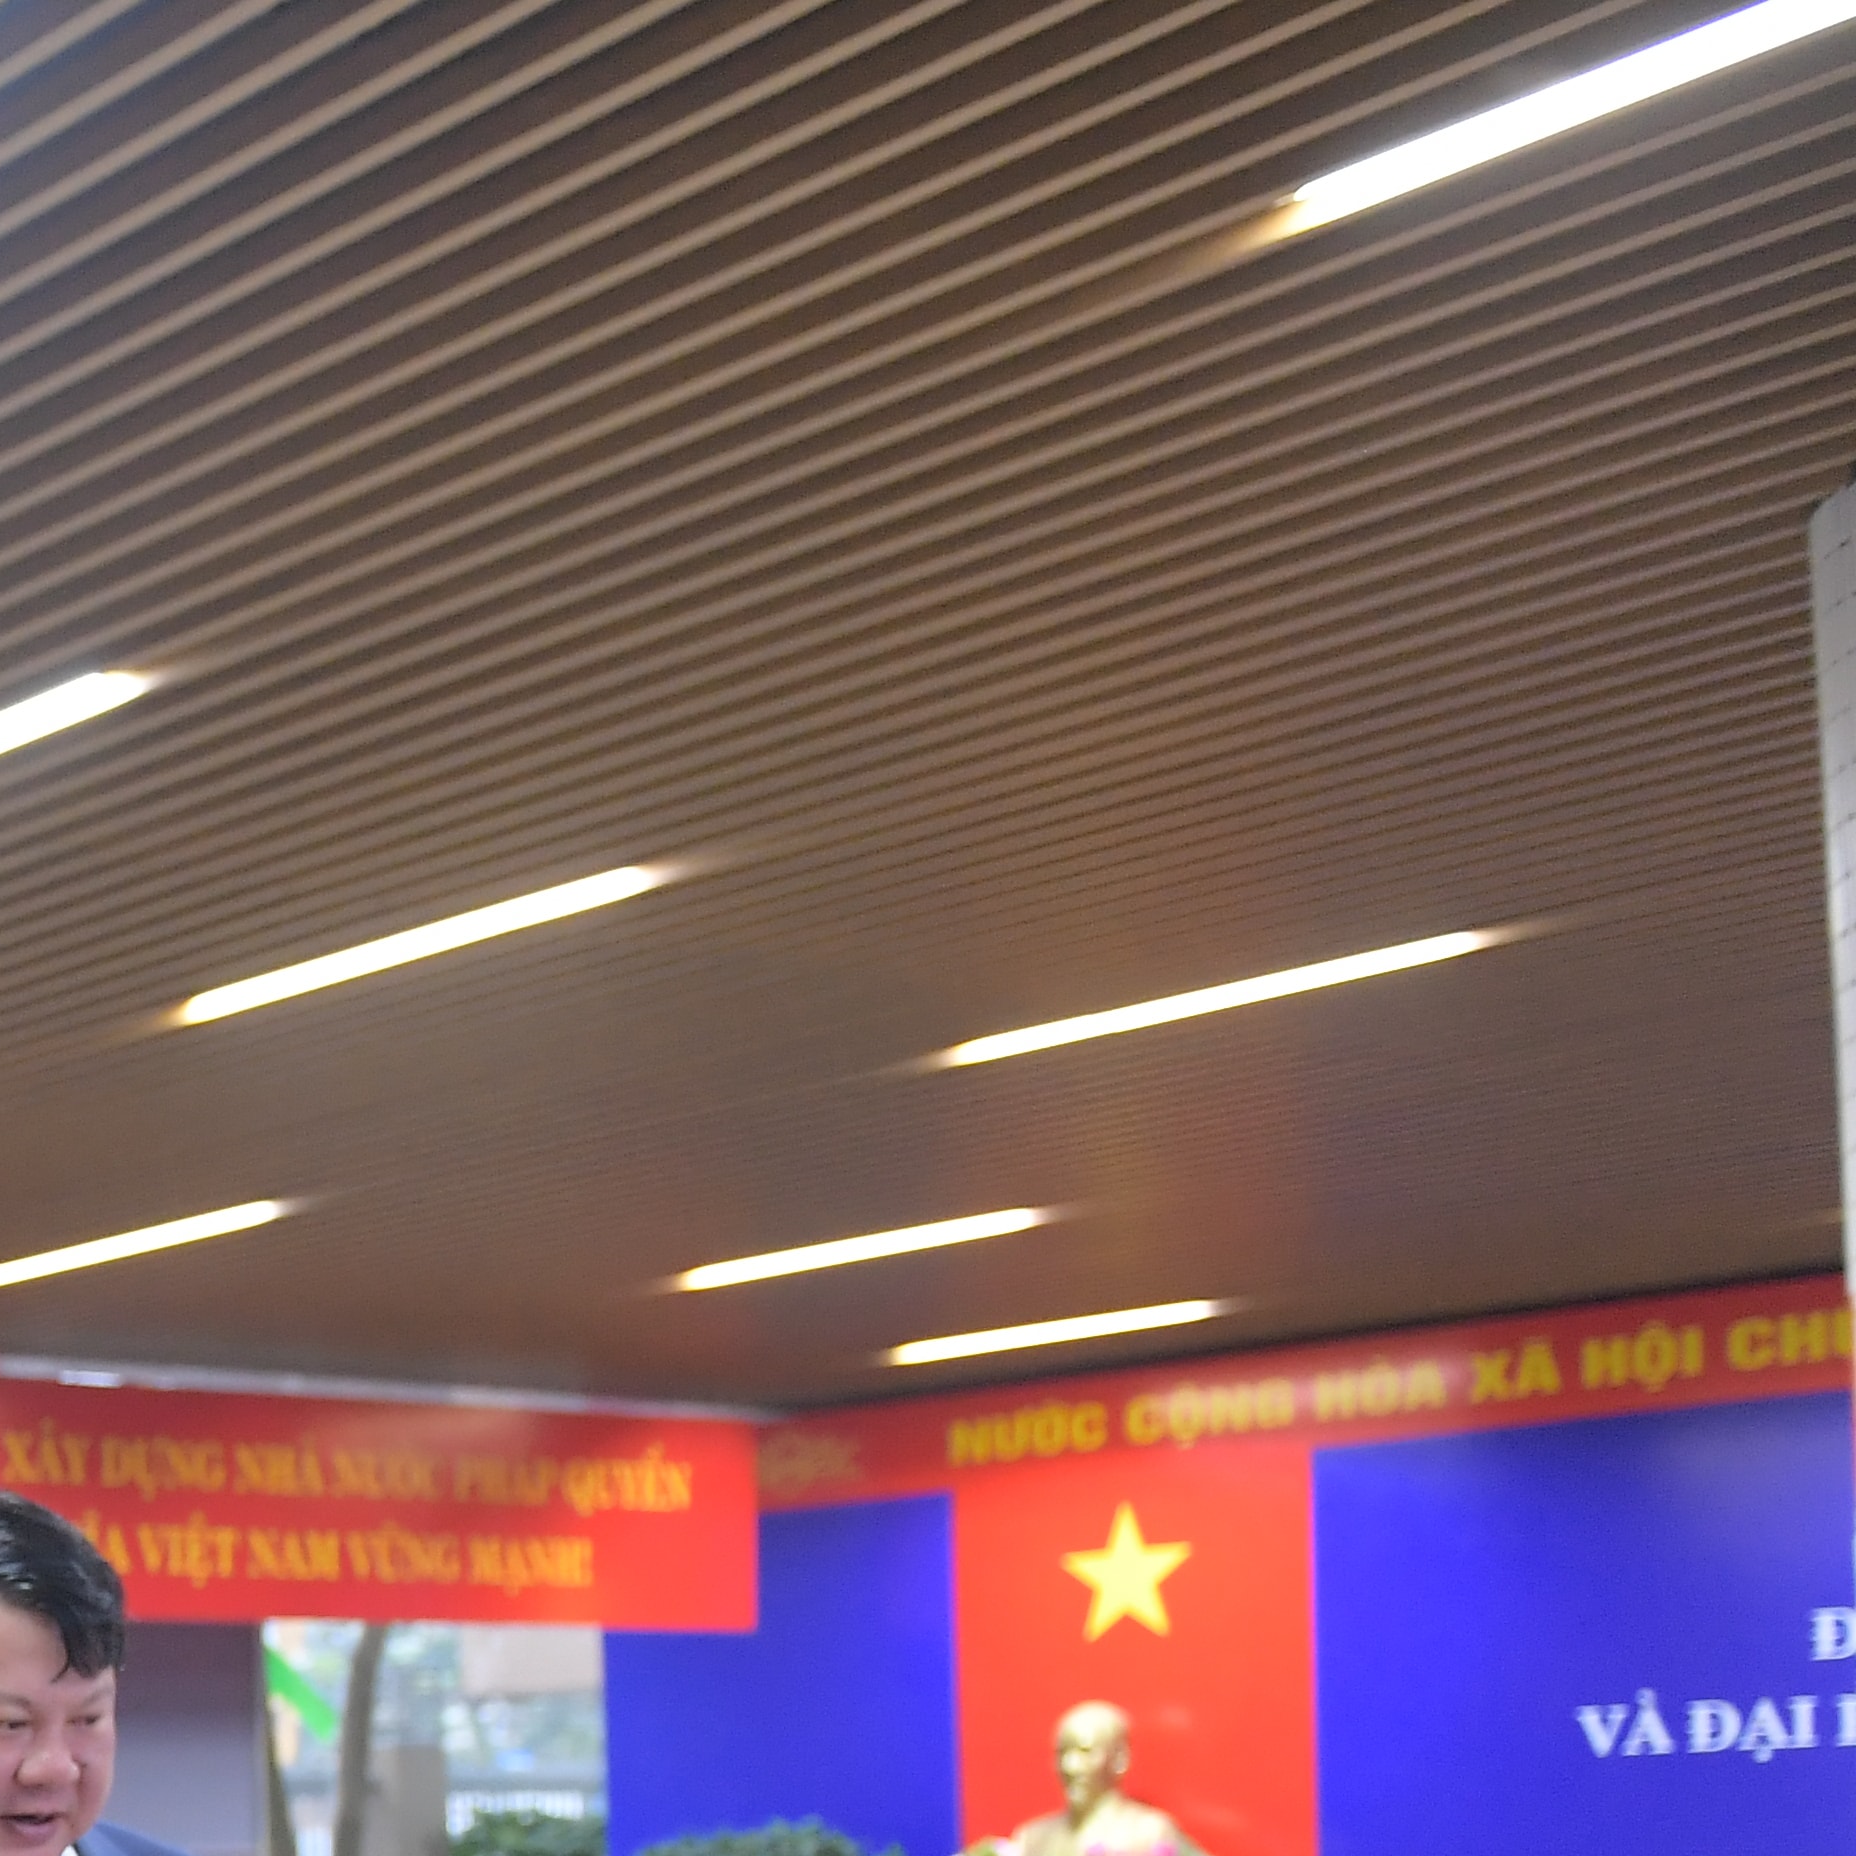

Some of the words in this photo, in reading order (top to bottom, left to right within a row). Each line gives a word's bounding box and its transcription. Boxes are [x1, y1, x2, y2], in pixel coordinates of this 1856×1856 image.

[1581, 1320, 1706, 1393] HỘI
[247, 1527, 340, 1581] NAM
[1574, 1687, 1676, 1759] VÀ
[1685, 1694, 1818, 1764] ĐẠI
